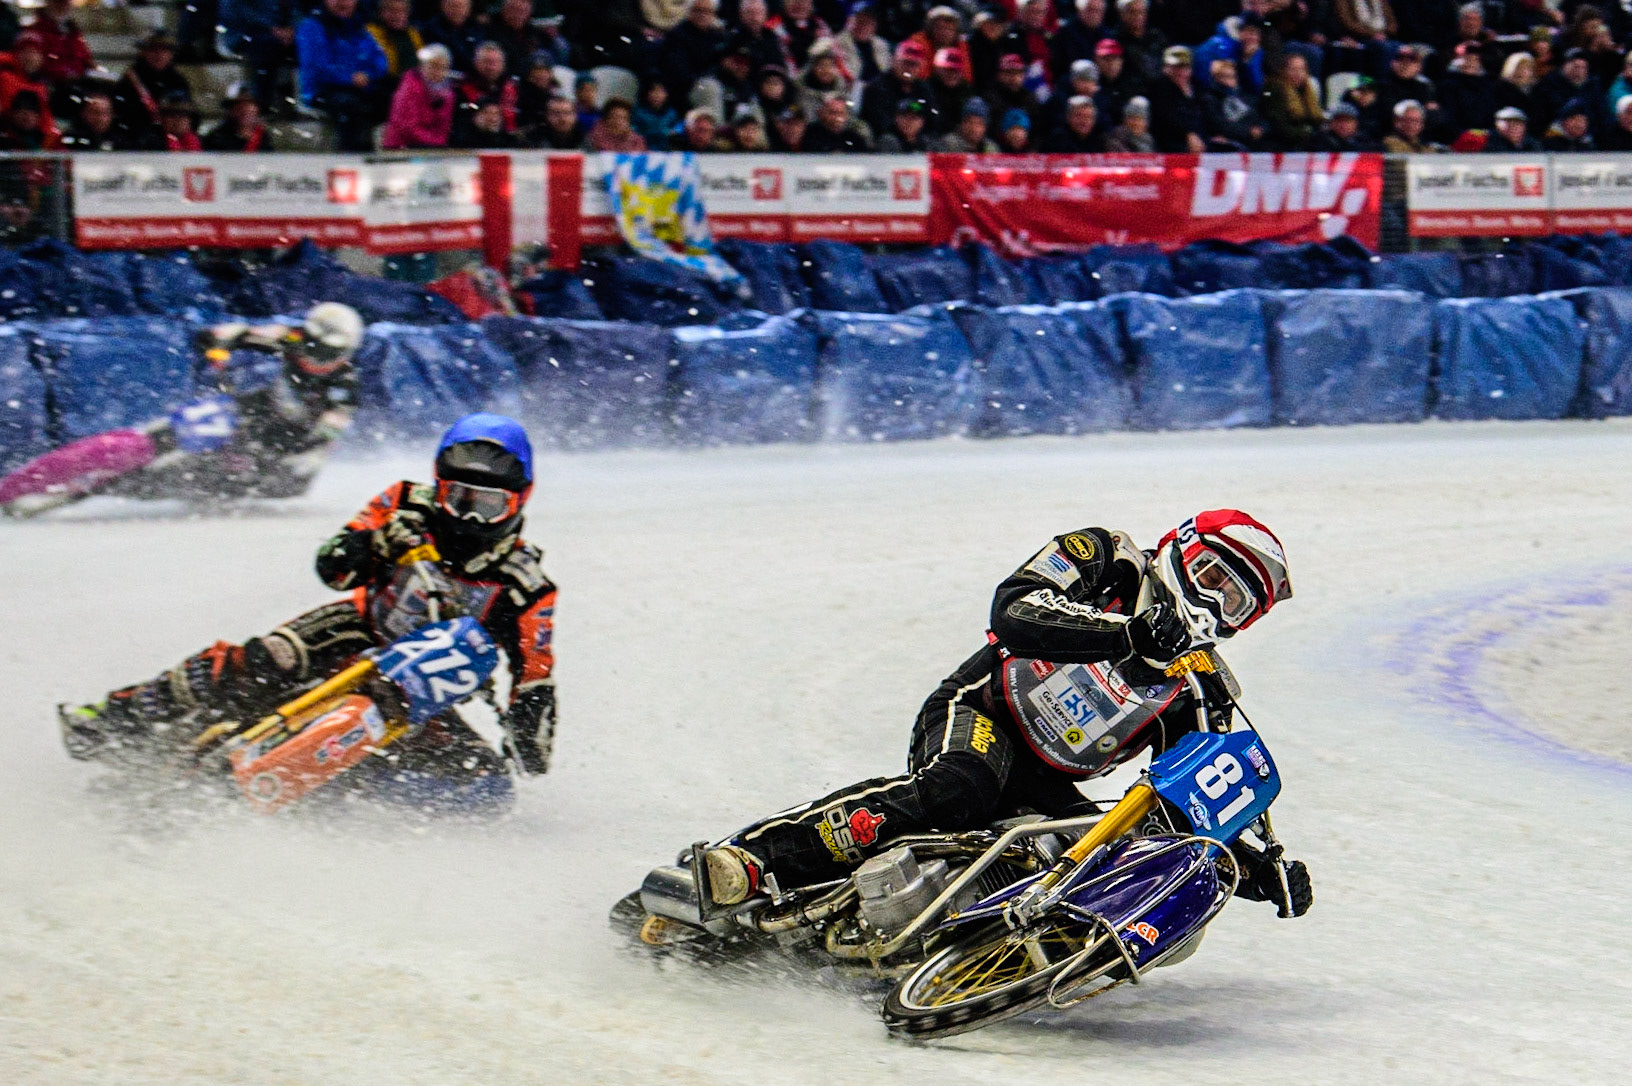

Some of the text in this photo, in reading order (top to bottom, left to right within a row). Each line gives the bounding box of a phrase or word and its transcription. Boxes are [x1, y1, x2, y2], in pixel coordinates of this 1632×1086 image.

[1191, 152, 1361, 217] DMV
[391, 627, 479, 703] 212
[1194, 752, 1256, 827] 81
